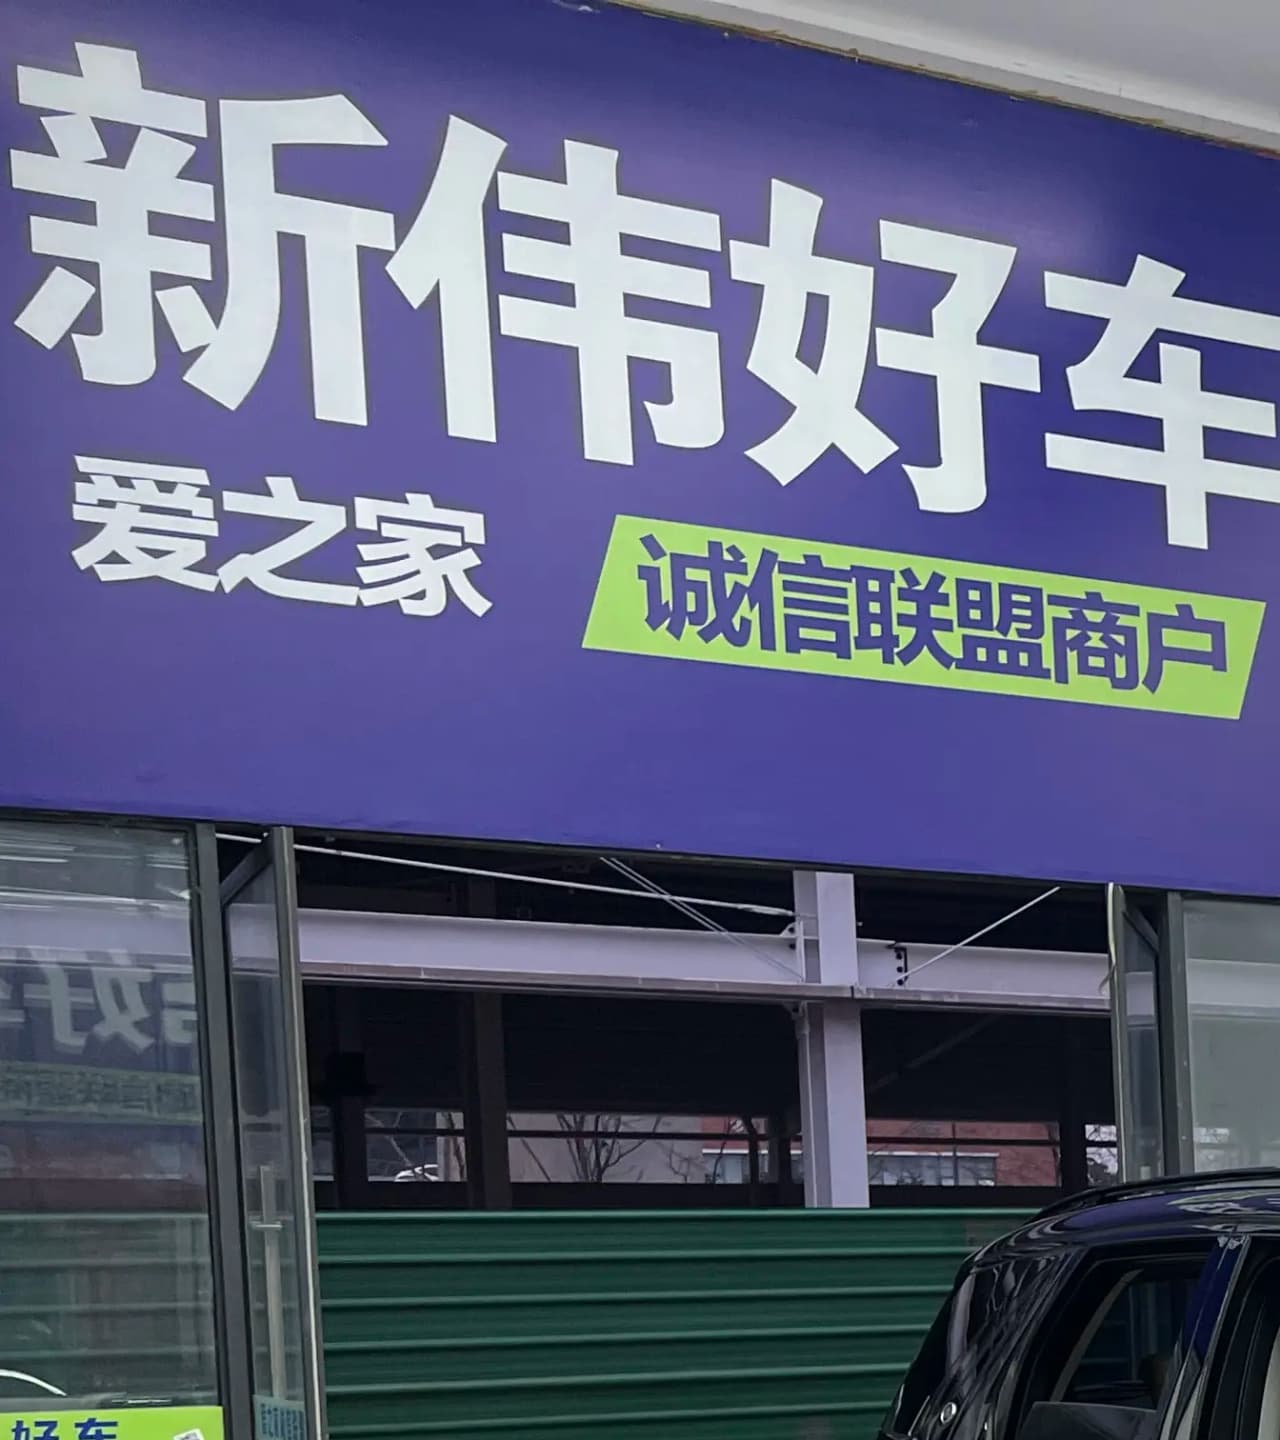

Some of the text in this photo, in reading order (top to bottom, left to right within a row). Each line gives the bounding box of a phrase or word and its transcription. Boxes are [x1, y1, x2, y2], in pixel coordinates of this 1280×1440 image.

[71, 455, 493, 617] 爱之家
[637, 534, 1228, 693] 诚信联盟商户
